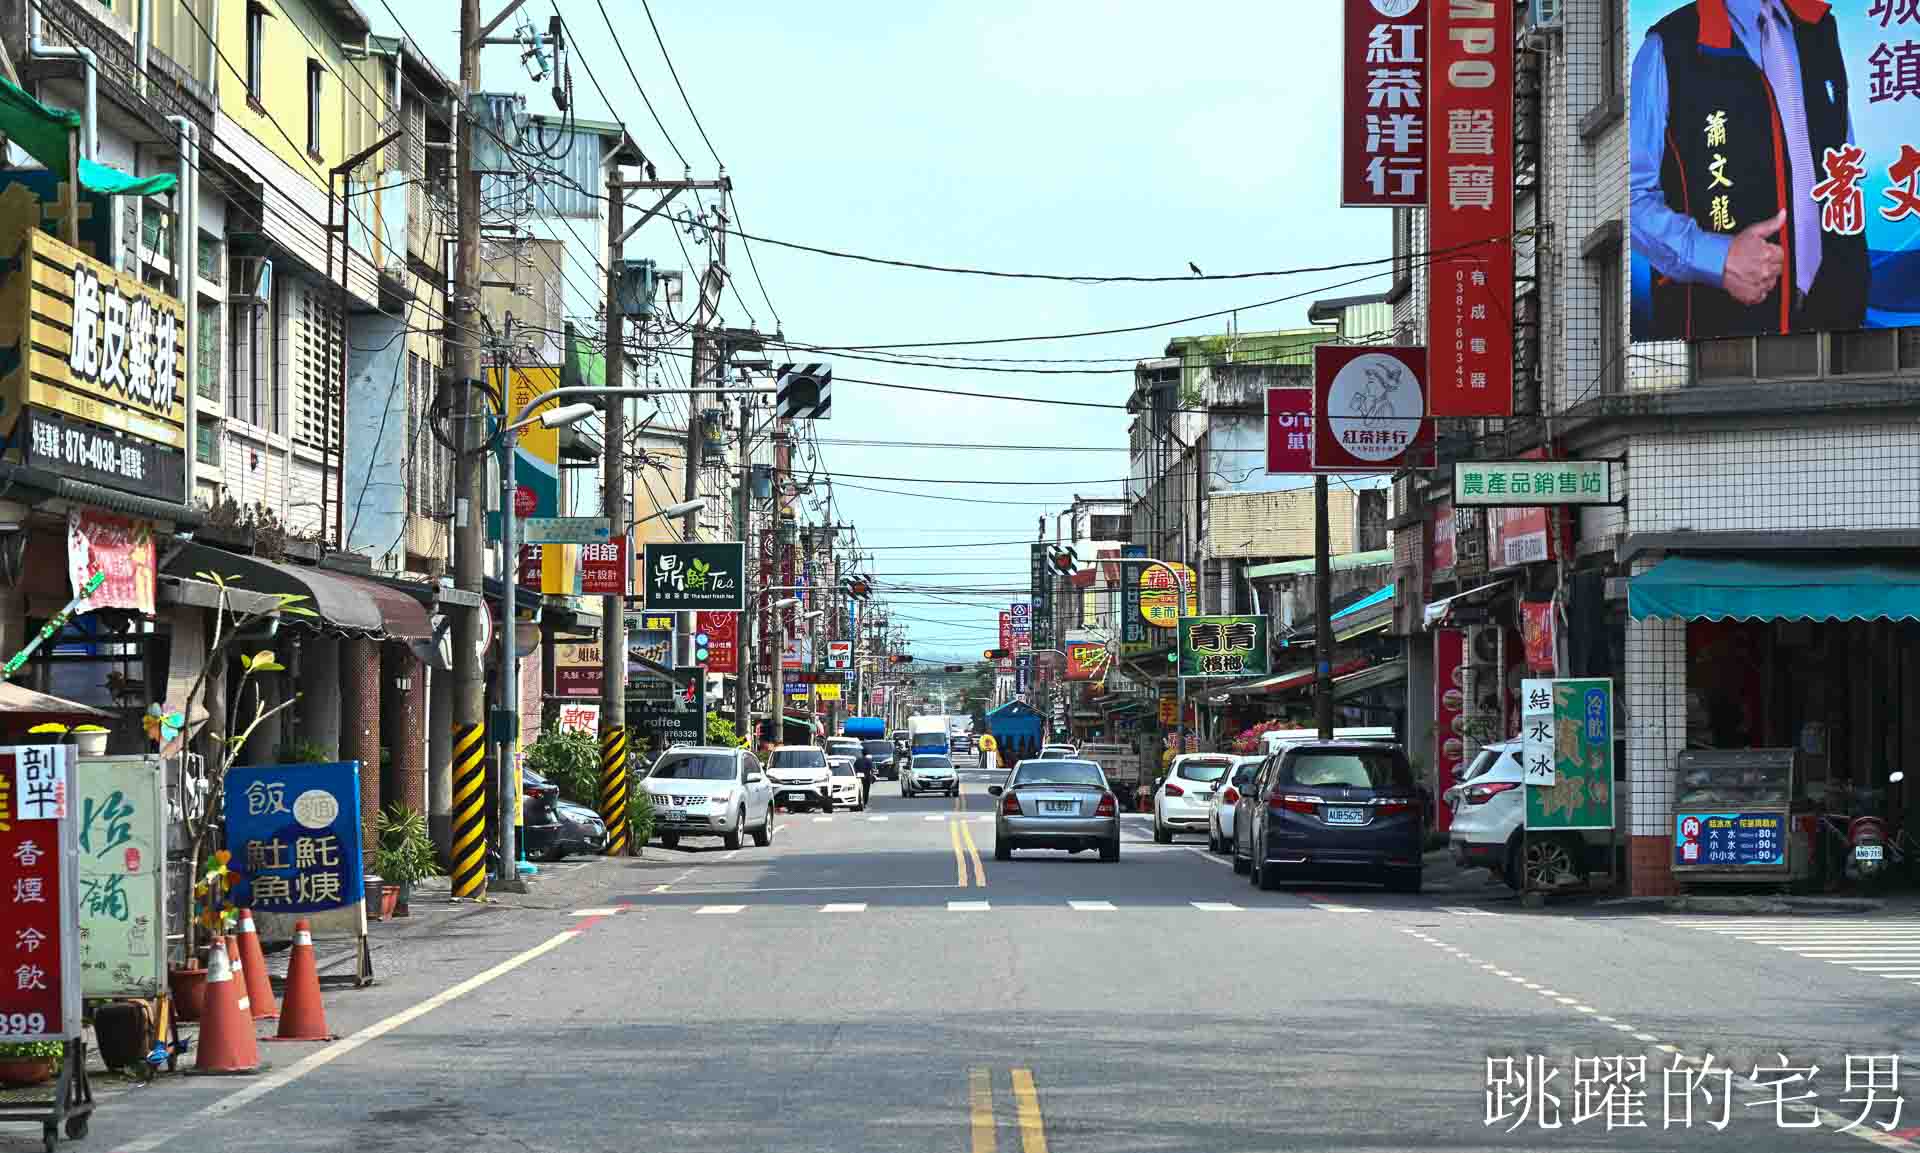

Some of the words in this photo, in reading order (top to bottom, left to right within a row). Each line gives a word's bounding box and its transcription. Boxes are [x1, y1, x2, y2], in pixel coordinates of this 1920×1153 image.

[1366, 24, 1423, 196] 紅茶洋行
[1448, 108, 1494, 211] 聲寶
[1703, 110, 1737, 231] 蕭文龍
[1470, 270, 1488, 389] 有成電器
[1343, 430, 1408, 444] 紅茶洋行
[1463, 471, 1601, 495] 農產品銷售站
[1189, 622, 1256, 651] 青青
[1528, 688, 1553, 776] 結水冰
[14, 840, 46, 902] 香煙
[15, 927, 47, 990] 冷飲
